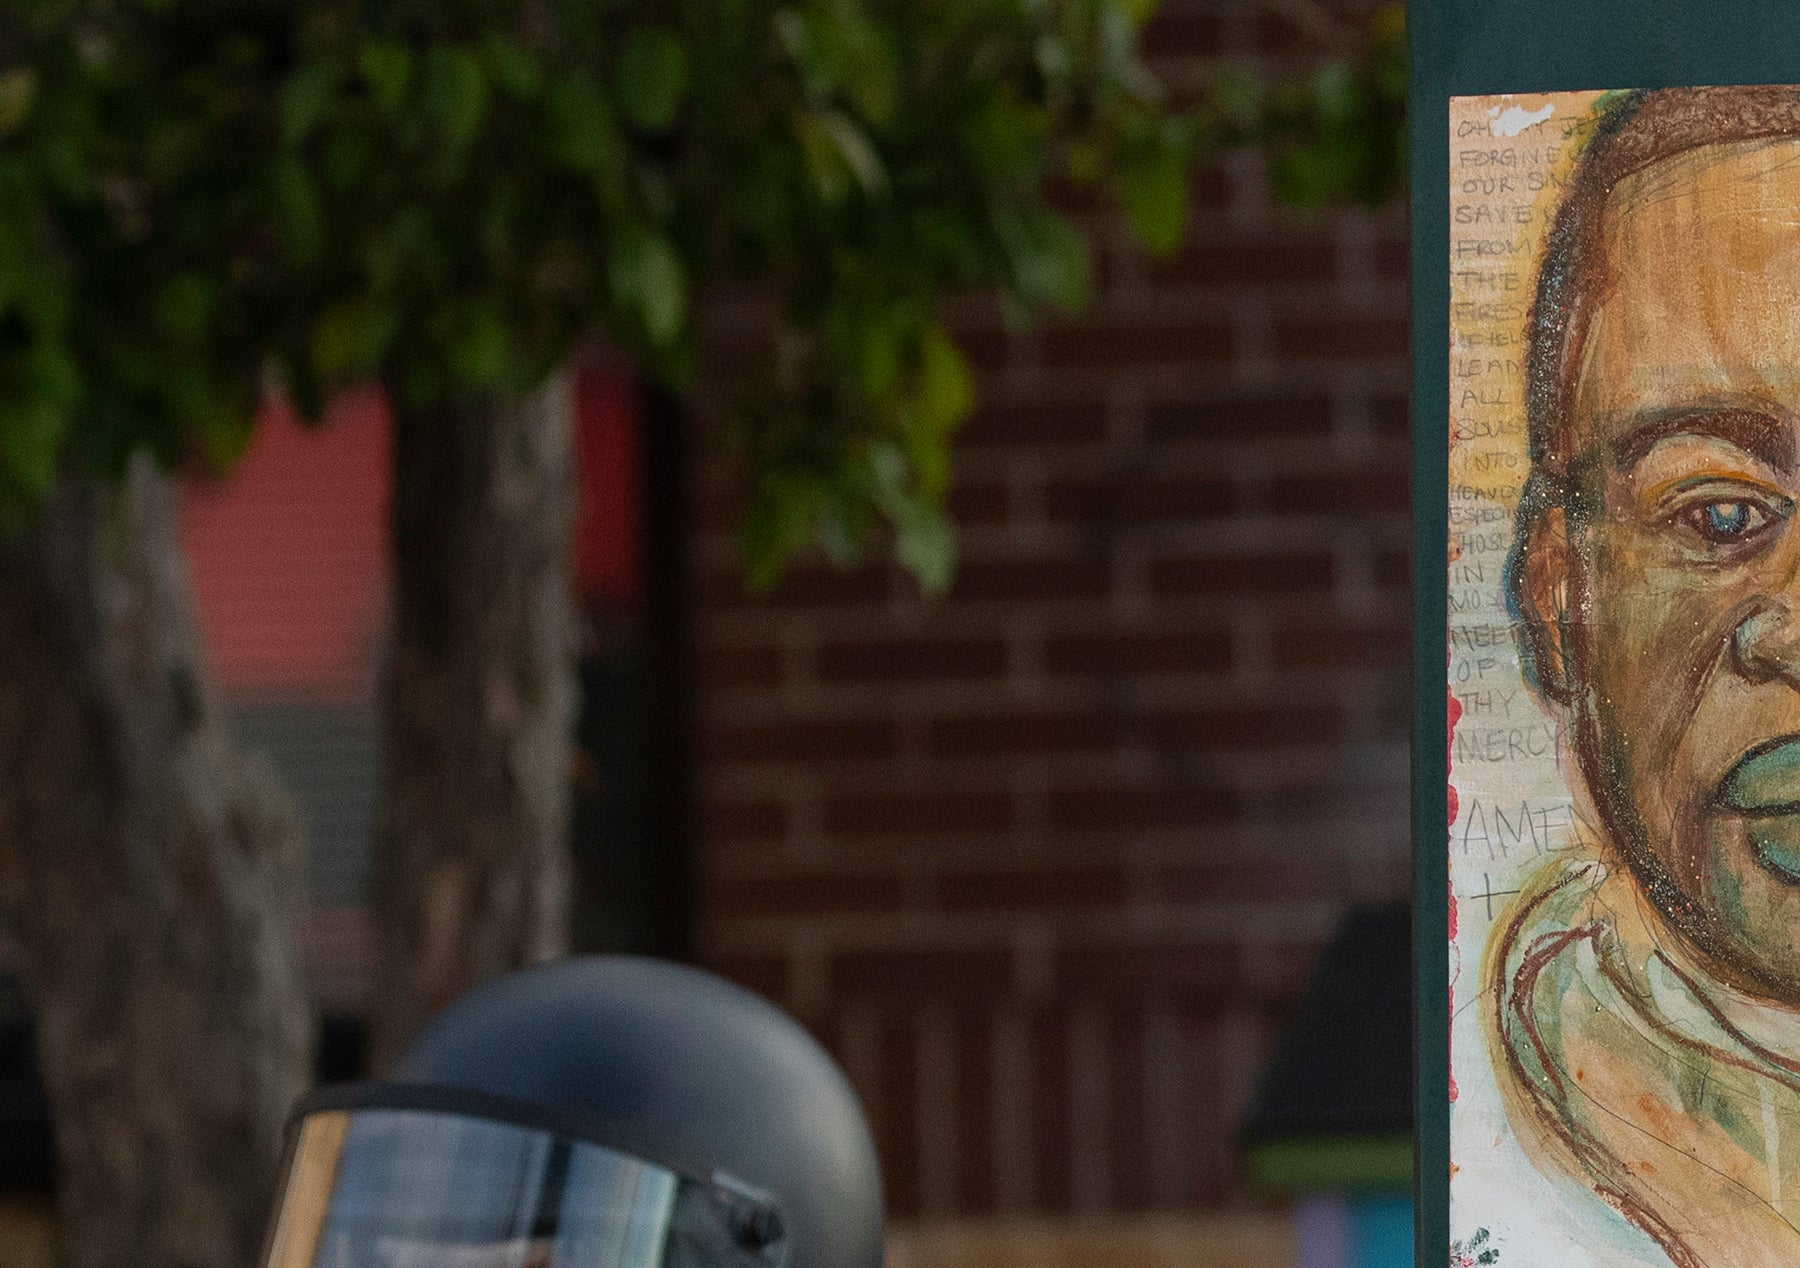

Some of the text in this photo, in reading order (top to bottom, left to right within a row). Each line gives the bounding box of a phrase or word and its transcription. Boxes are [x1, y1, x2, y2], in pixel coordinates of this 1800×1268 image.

[1462, 176, 1515, 196] OUR
[1455, 203, 1534, 224] SAVE
[1455, 238, 1532, 259] FROM
[1456, 272, 1520, 292] THE
[1460, 388, 1512, 409] ALL
[1454, 559, 1485, 584] IN
[1456, 690, 1517, 719] THY
[1455, 722, 1565, 772] MERCY
